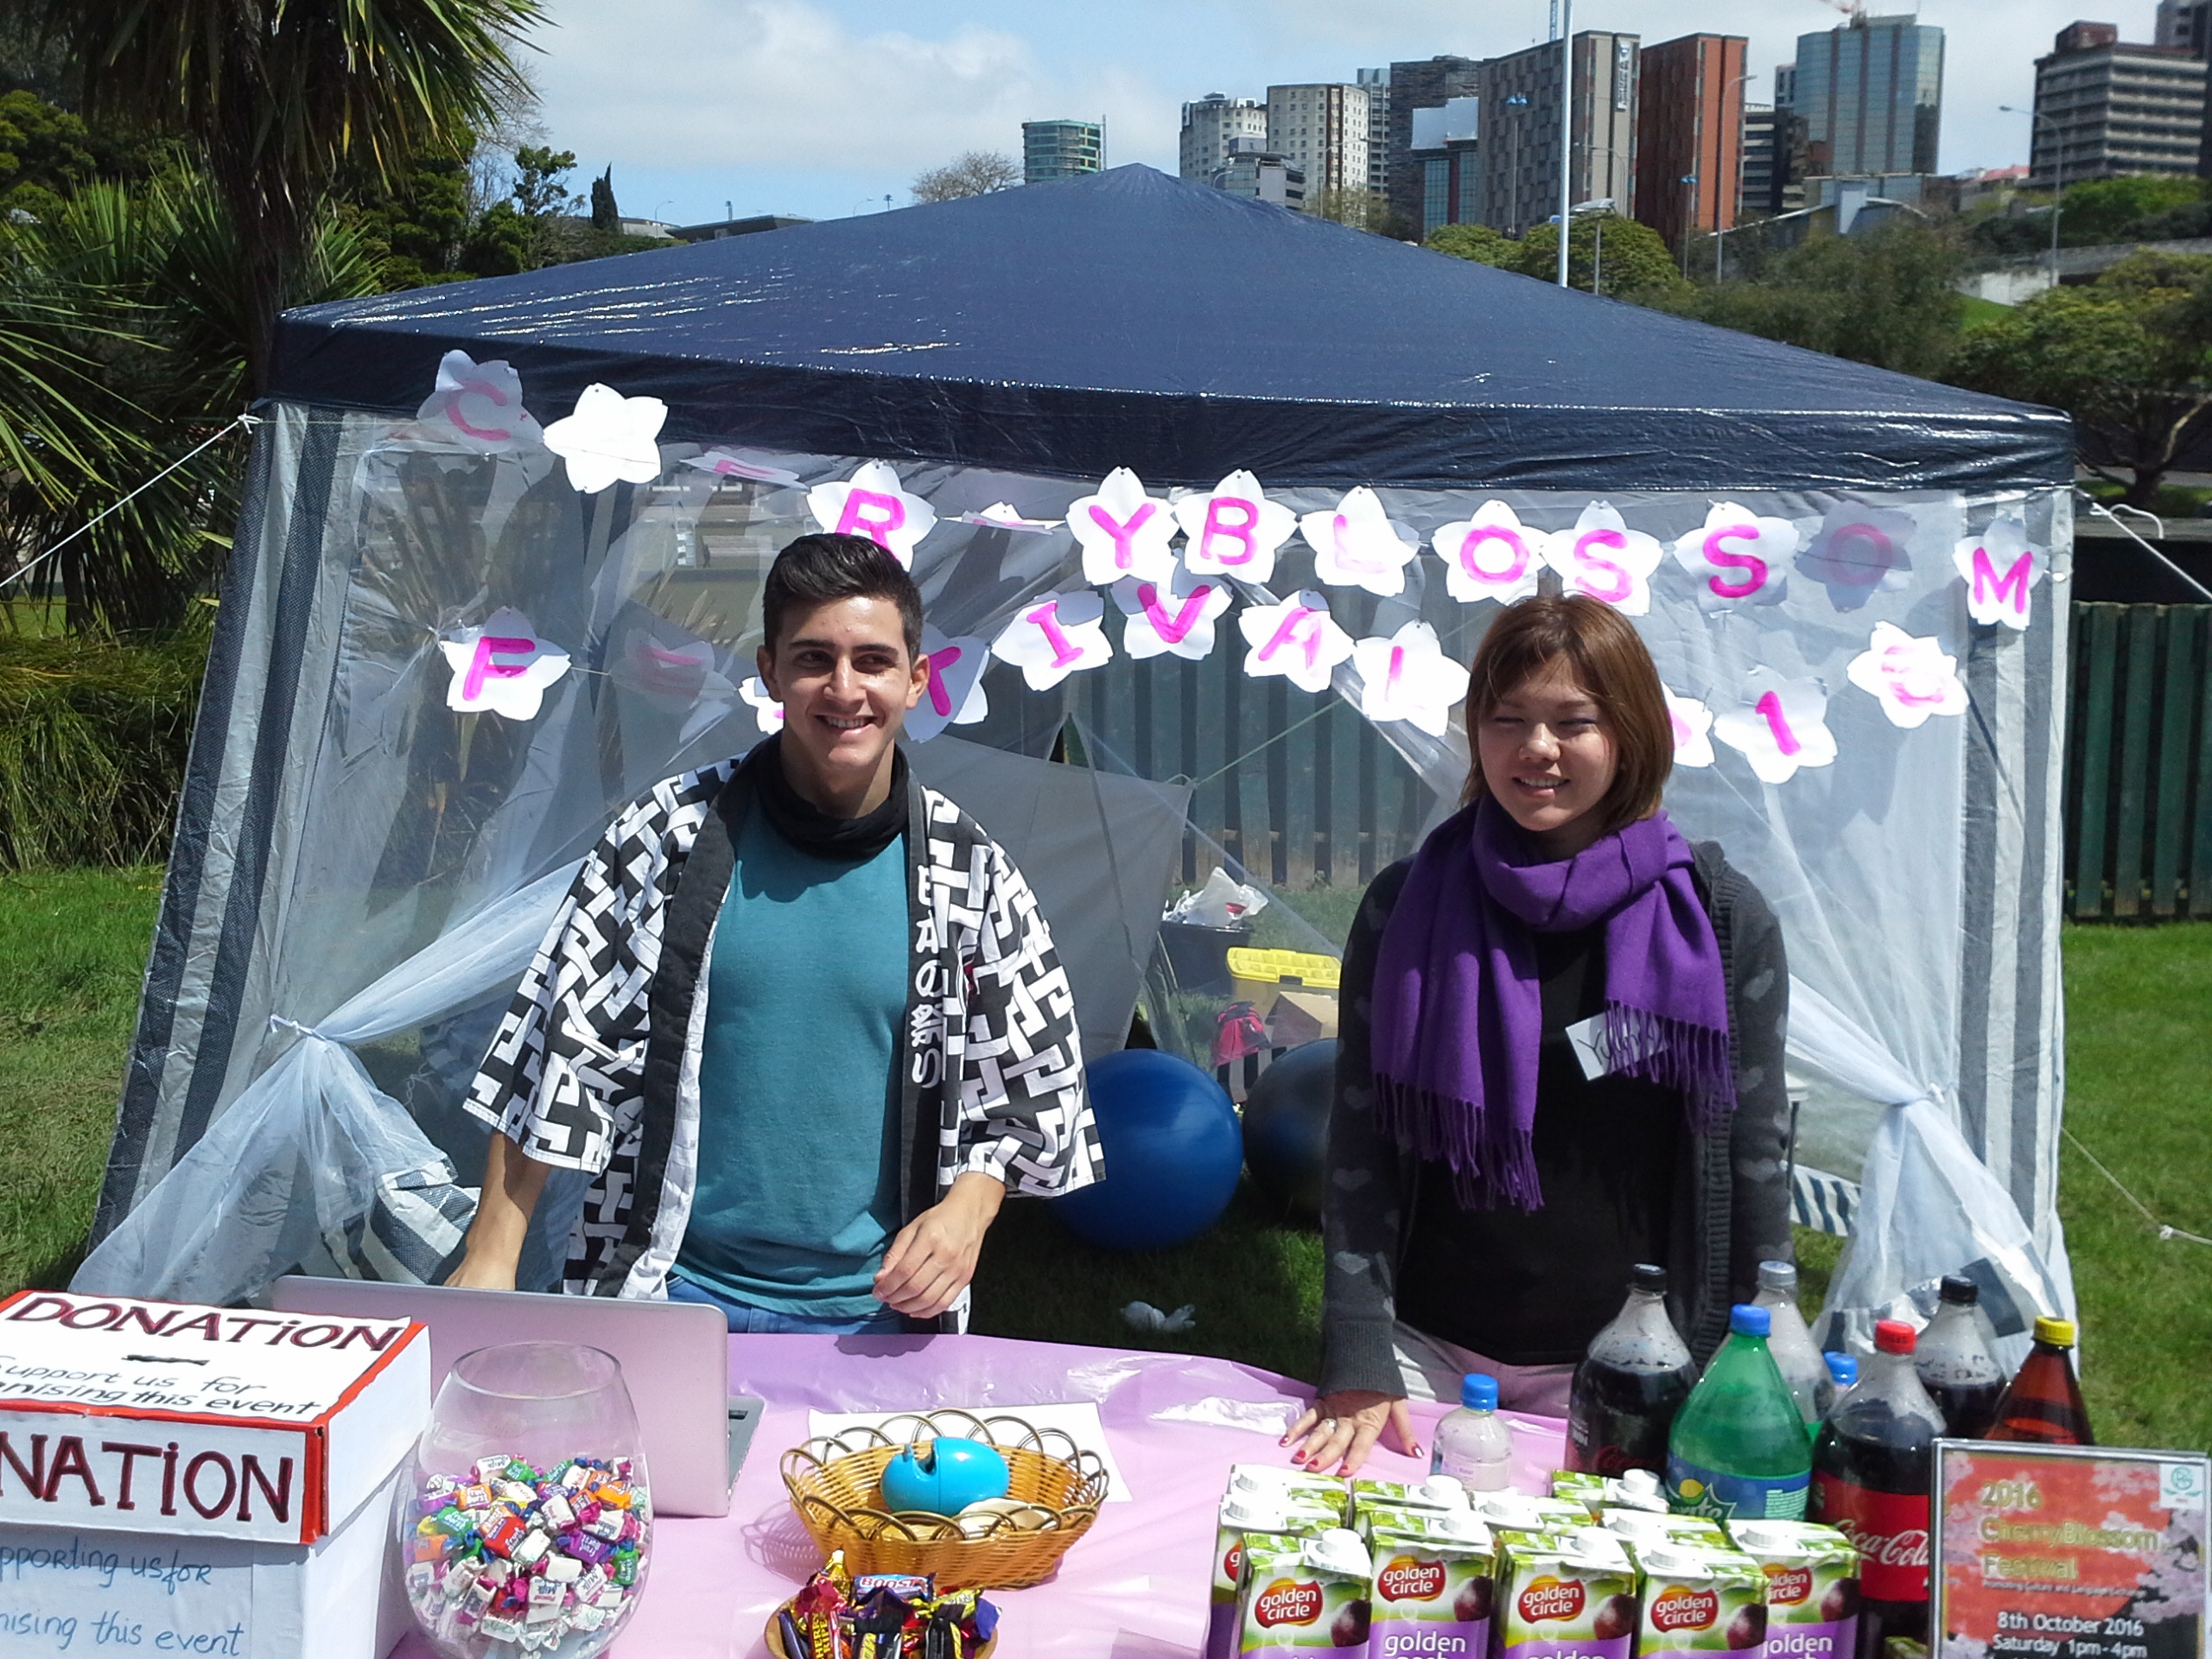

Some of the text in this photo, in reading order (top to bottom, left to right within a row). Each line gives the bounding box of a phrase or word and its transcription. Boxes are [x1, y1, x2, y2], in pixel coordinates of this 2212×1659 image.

[133, 1375, 178, 1388] us
[200, 1376, 267, 1395] for
[0, 1382, 322, 1414] nising this event
[1981, 1481, 2042, 1509] 2016
[1383, 1567, 1440, 1586] golden
[1984, 1554, 2078, 1580] Festival
[1390, 1580, 1433, 1595] circle
[1770, 1573, 1808, 1586] lden
[1260, 1588, 1317, 1612] golden
[1523, 1586, 1580, 1608] golden
[1769, 1585, 1802, 1599] ircle
[1267, 1603, 1310, 1620] circle
[1530, 1600, 1573, 1616] circle
[1656, 1596, 1713, 1617] golden
[1663, 1610, 1706, 1625] circle
[91, 1611, 142, 1645] this
[156, 1622, 245, 1656] event
[1998, 1611, 2145, 1637] 8th October 2016
[812, 1612, 824, 1659] HERRY
[1384, 1630, 1466, 1657] golden
[1993, 1633, 2061, 1656] Saturday
